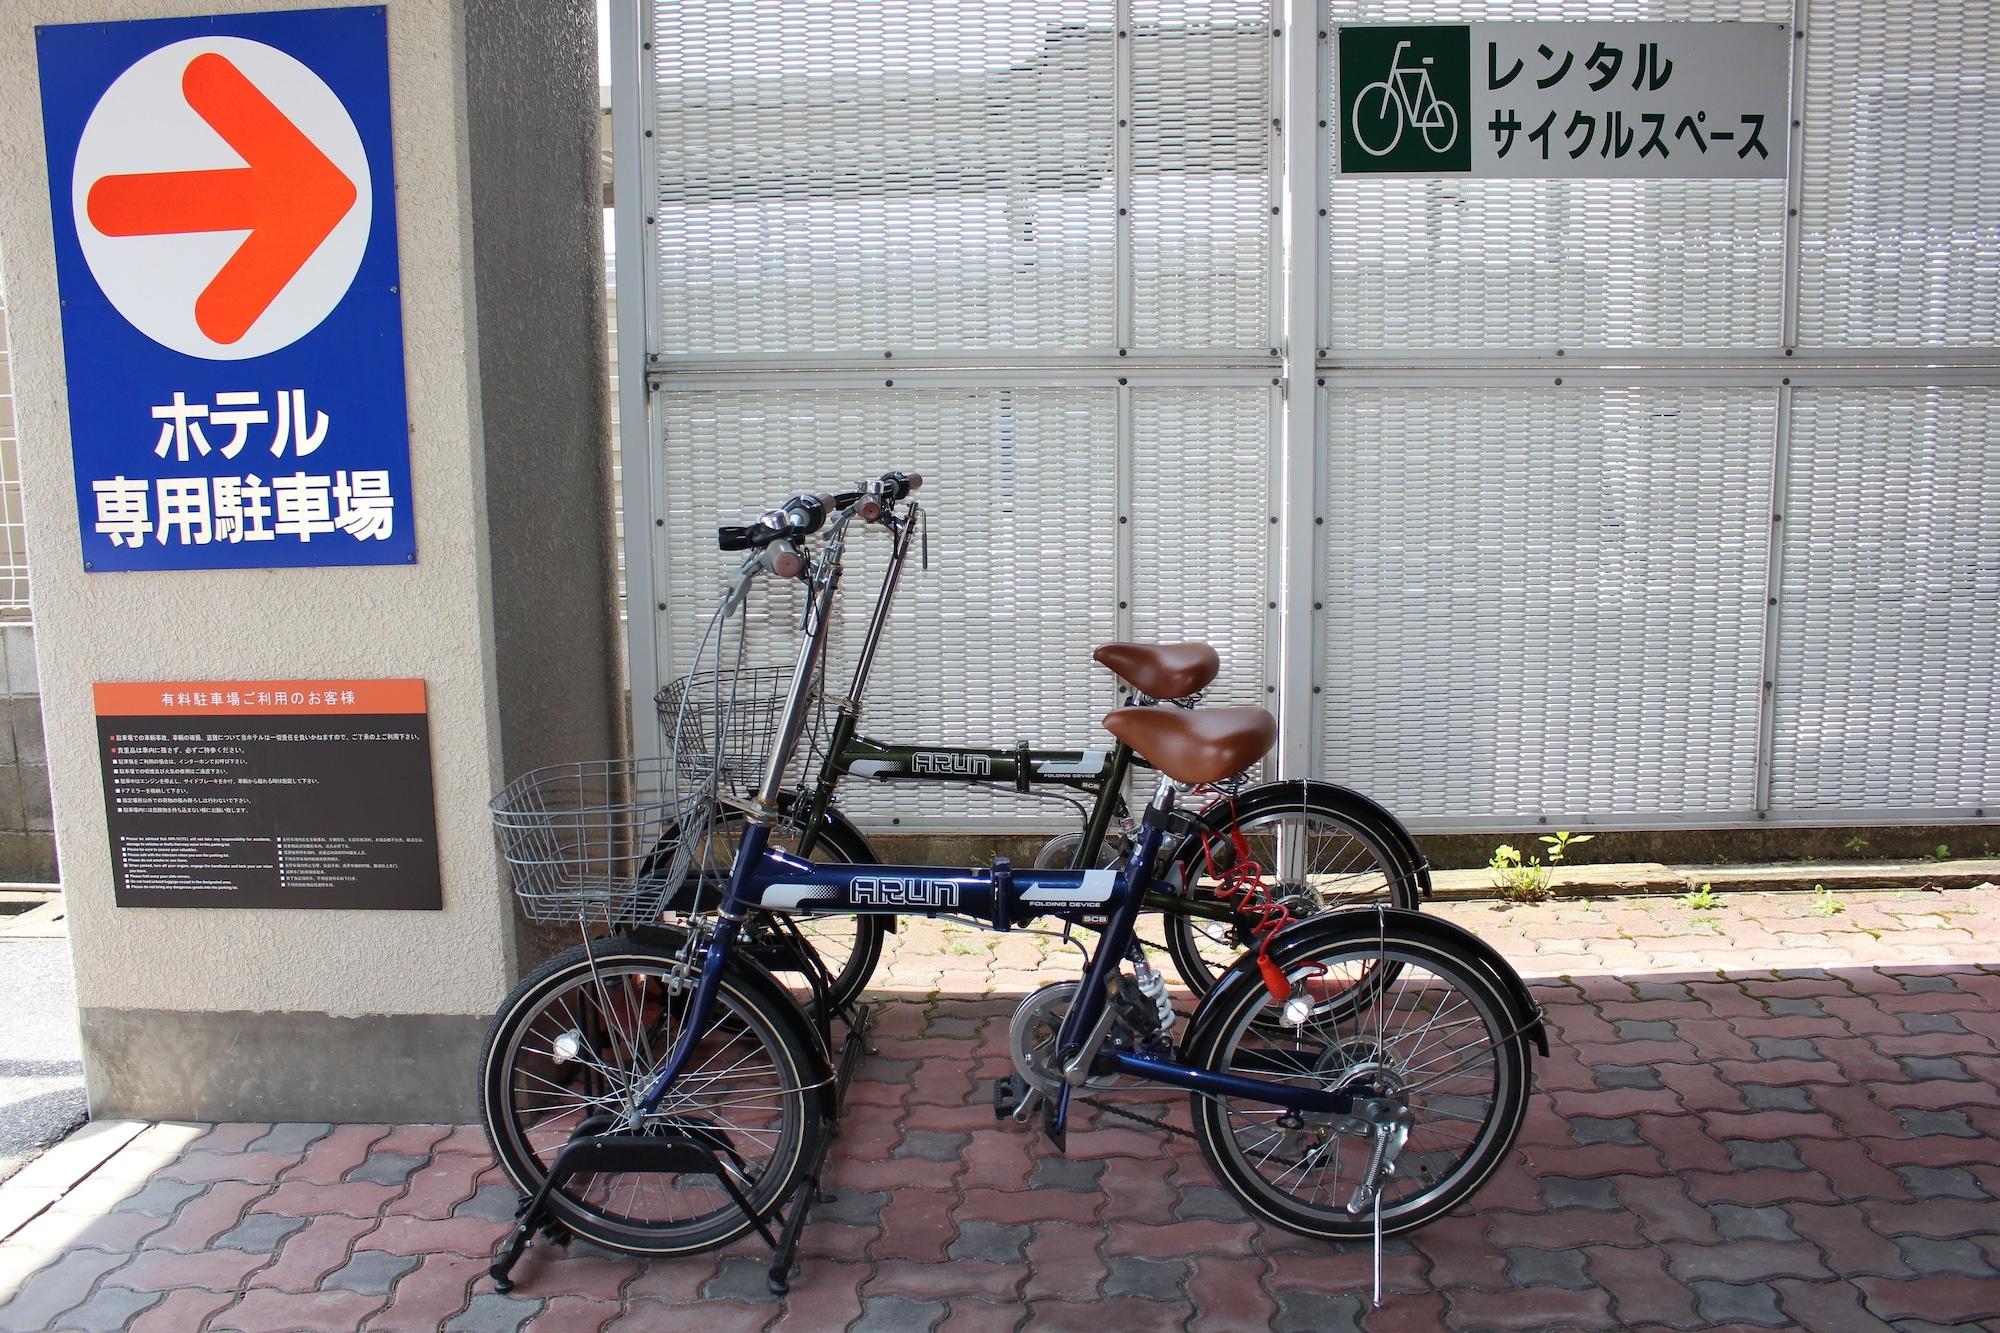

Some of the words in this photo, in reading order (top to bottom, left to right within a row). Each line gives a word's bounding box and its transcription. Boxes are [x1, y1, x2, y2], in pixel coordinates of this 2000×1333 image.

[1487, 42, 1673, 92] レンタル
[1487, 109, 1769, 160] サイクルスペース
[151, 389, 329, 462] ホテル
[92, 470, 394, 549] 専用駐車場
[161, 691, 356, 706] 有料駐車場ご利用のお客様
[911, 752, 991, 776] ARUN
[850, 876, 960, 907] ARUN
